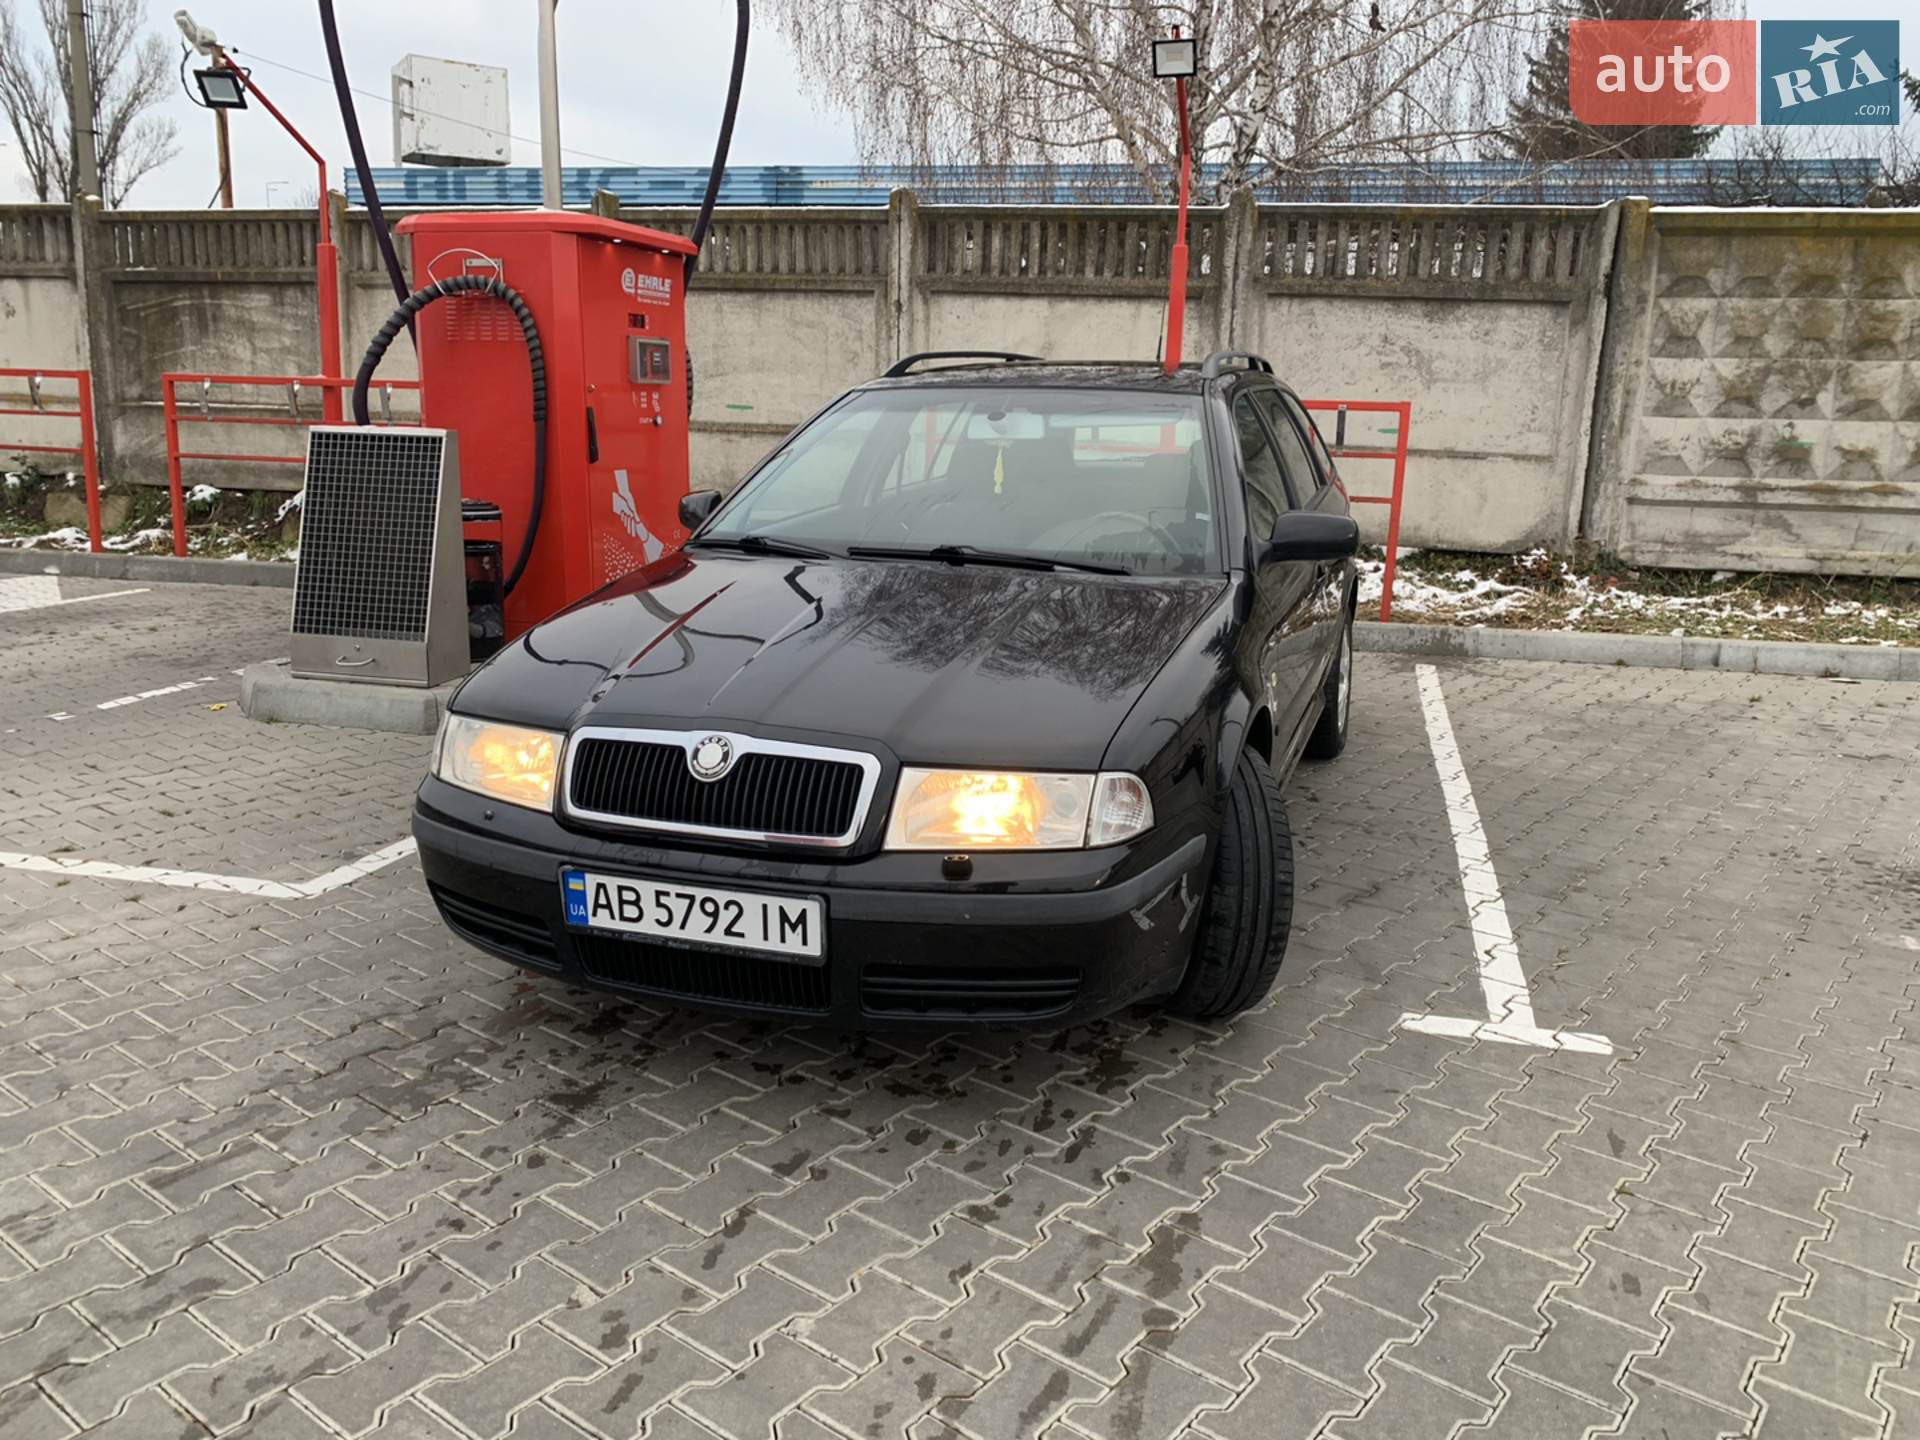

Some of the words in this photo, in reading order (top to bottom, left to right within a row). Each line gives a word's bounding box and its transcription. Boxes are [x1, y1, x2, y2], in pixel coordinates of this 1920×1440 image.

[637, 274, 672, 292] EHRLE
[570, 903, 586, 917] UA
[591, 882, 644, 923] AB
[654, 889, 745, 938] 5792
[762, 903, 808, 946] IM
